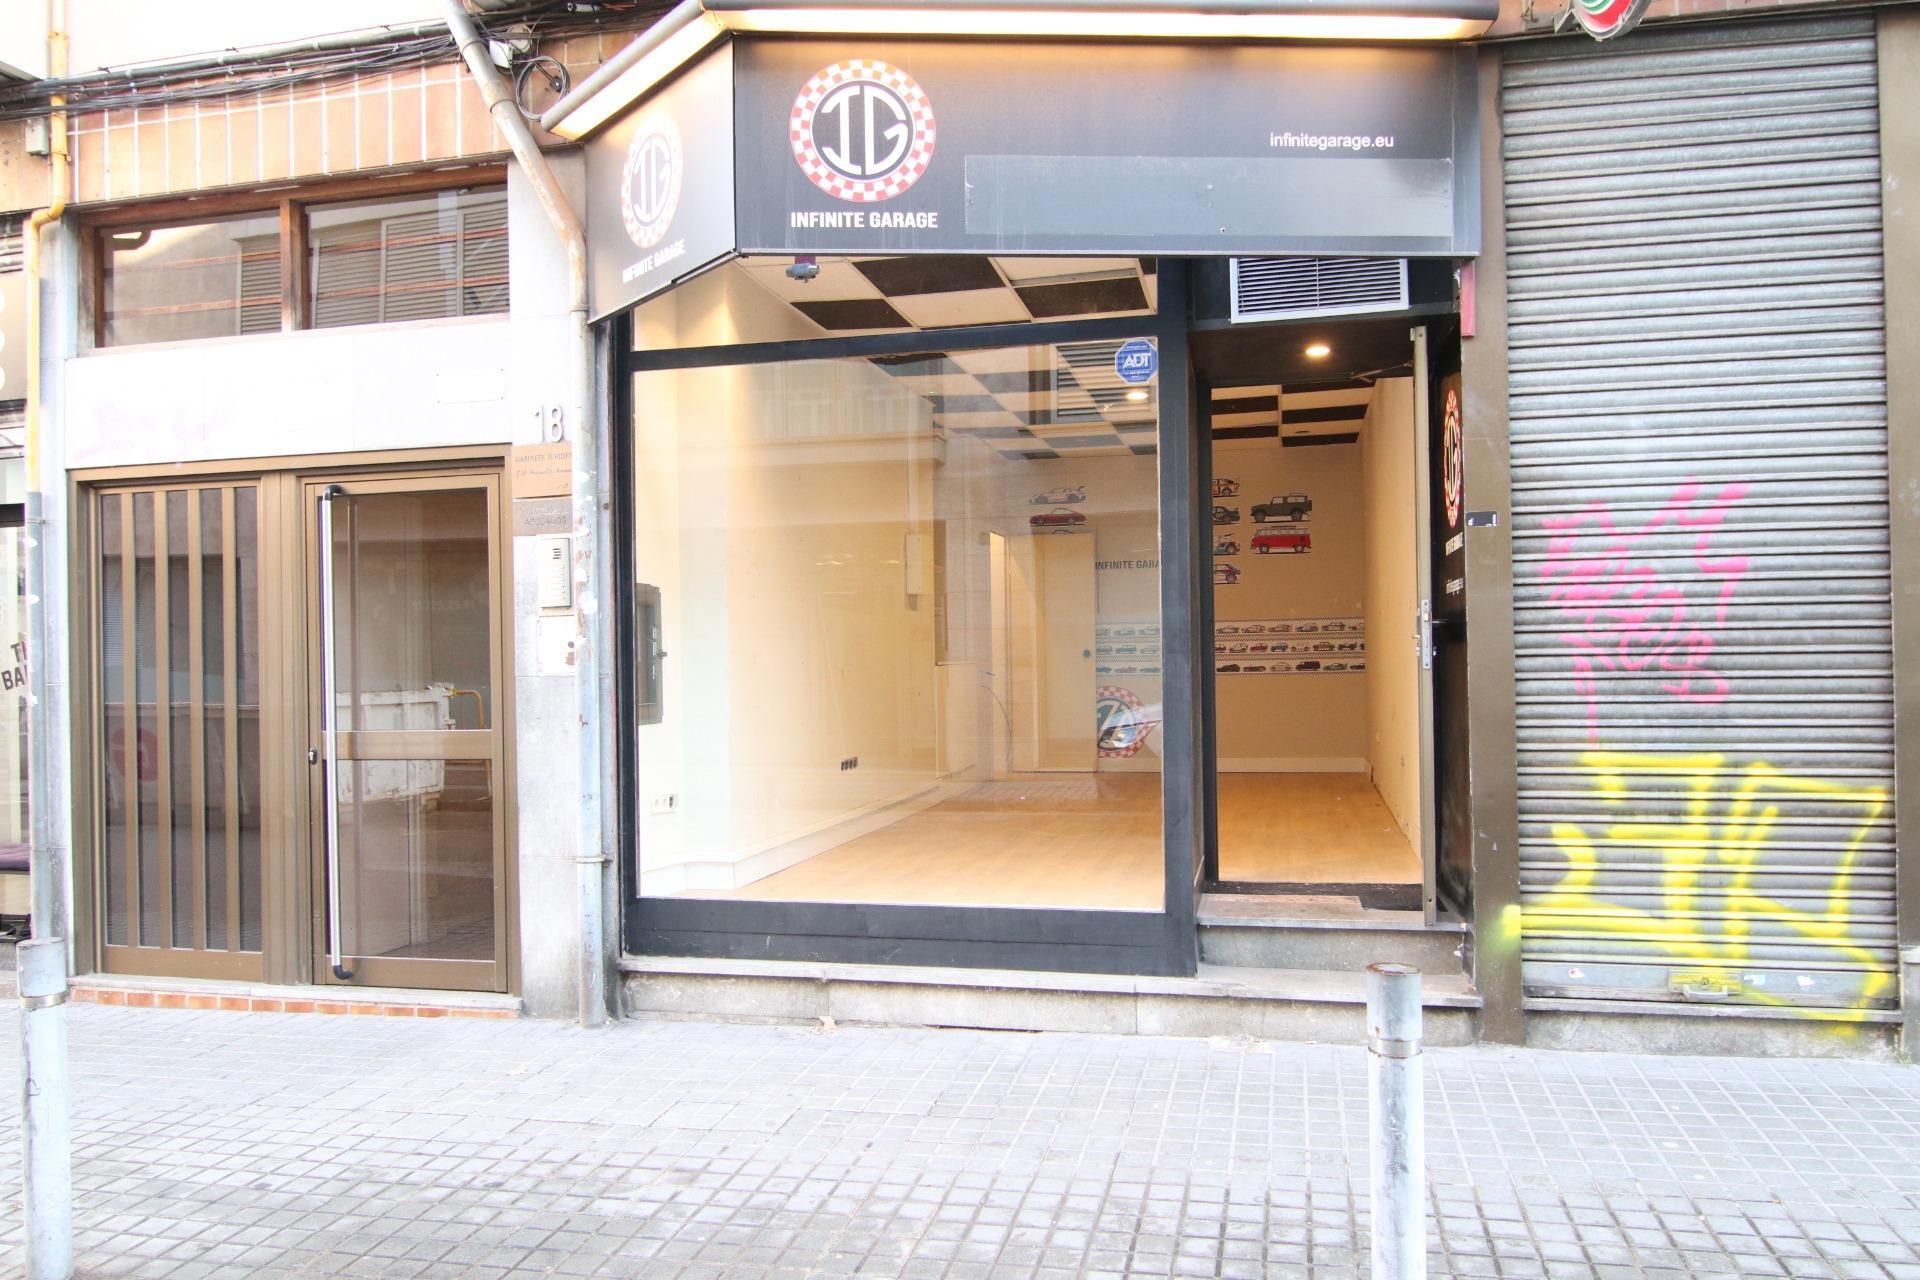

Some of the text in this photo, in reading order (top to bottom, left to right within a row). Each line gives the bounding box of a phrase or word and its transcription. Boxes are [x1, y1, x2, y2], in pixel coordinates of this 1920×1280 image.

[1270, 132, 1394, 150] infinitegarage.eu
[791, 212, 938, 228] INFINITE GARAGE
[622, 239, 686, 283] INFINITE GARAGE
[1123, 353, 1151, 368] ADT
[531, 403, 564, 443] 18
[1095, 560, 1134, 570] INFINITE
